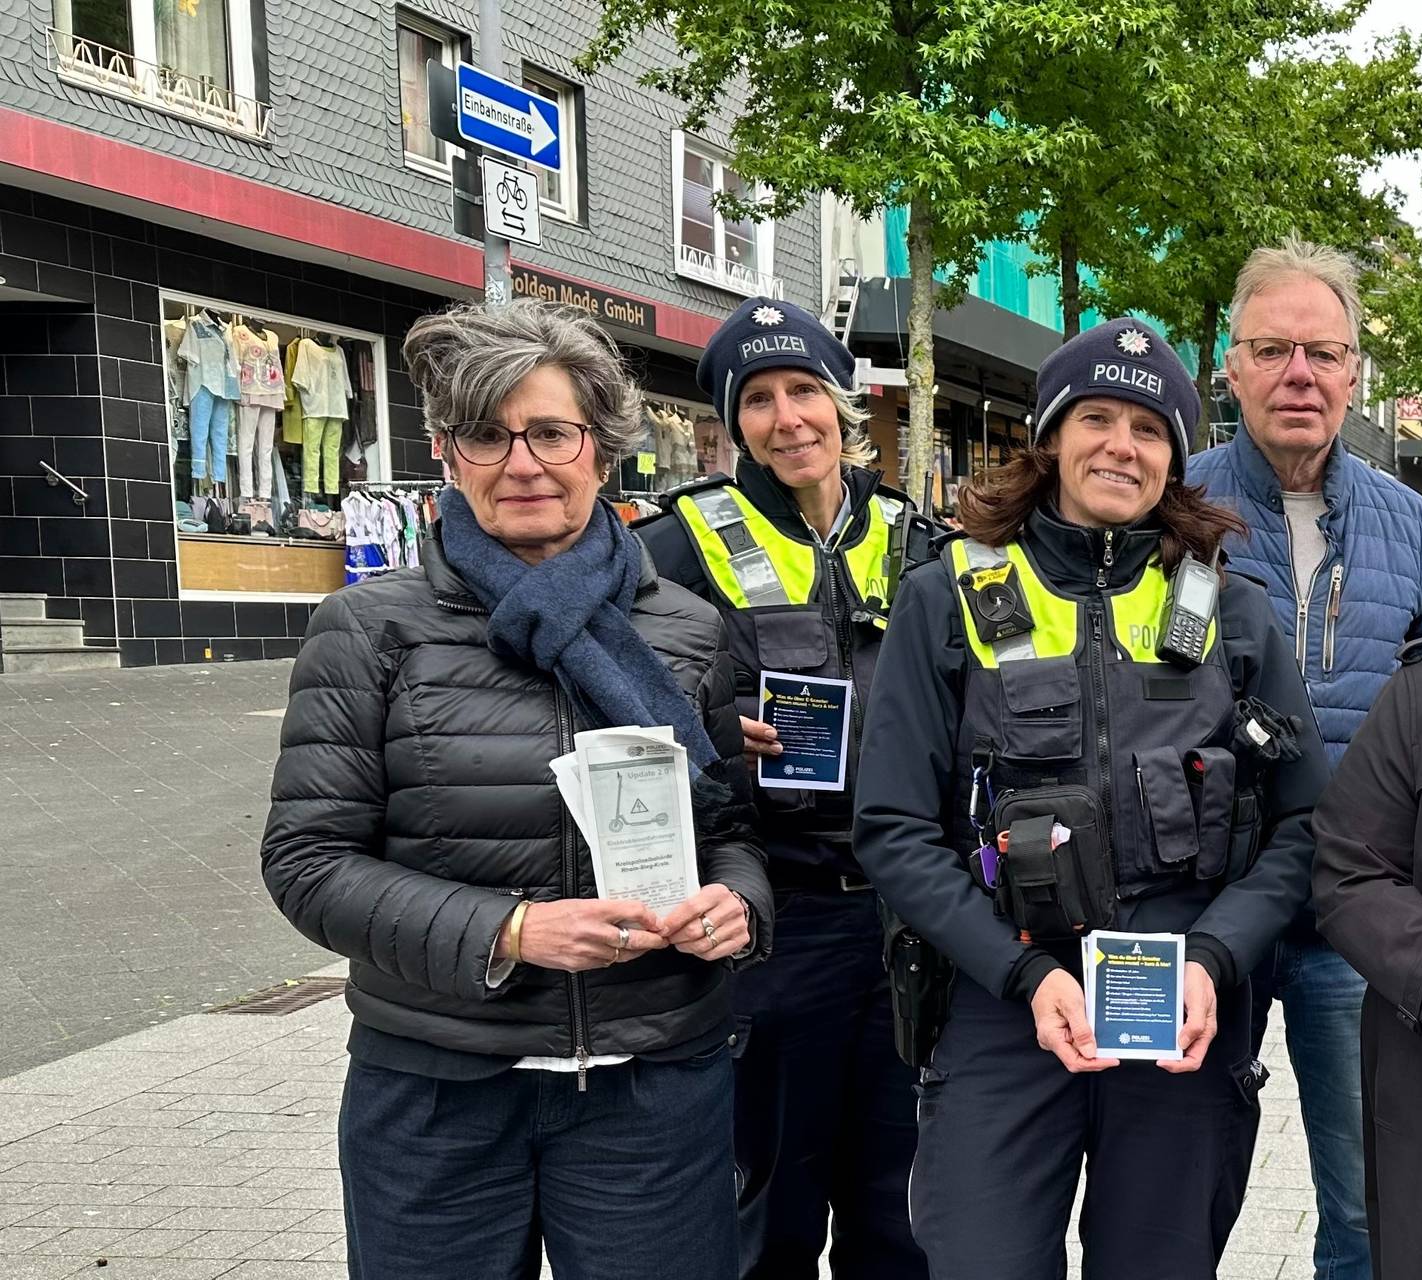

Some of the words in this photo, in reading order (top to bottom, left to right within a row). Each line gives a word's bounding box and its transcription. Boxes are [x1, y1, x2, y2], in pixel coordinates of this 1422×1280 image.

[463, 92, 533, 135] Einbahnstraße
[511, 272, 556, 302] olden
[560, 284, 598, 314] Mode
[603, 298, 645, 327] GmbH
[741, 335, 806, 359] POLIZEI
[1093, 363, 1163, 396] POLIZEI
